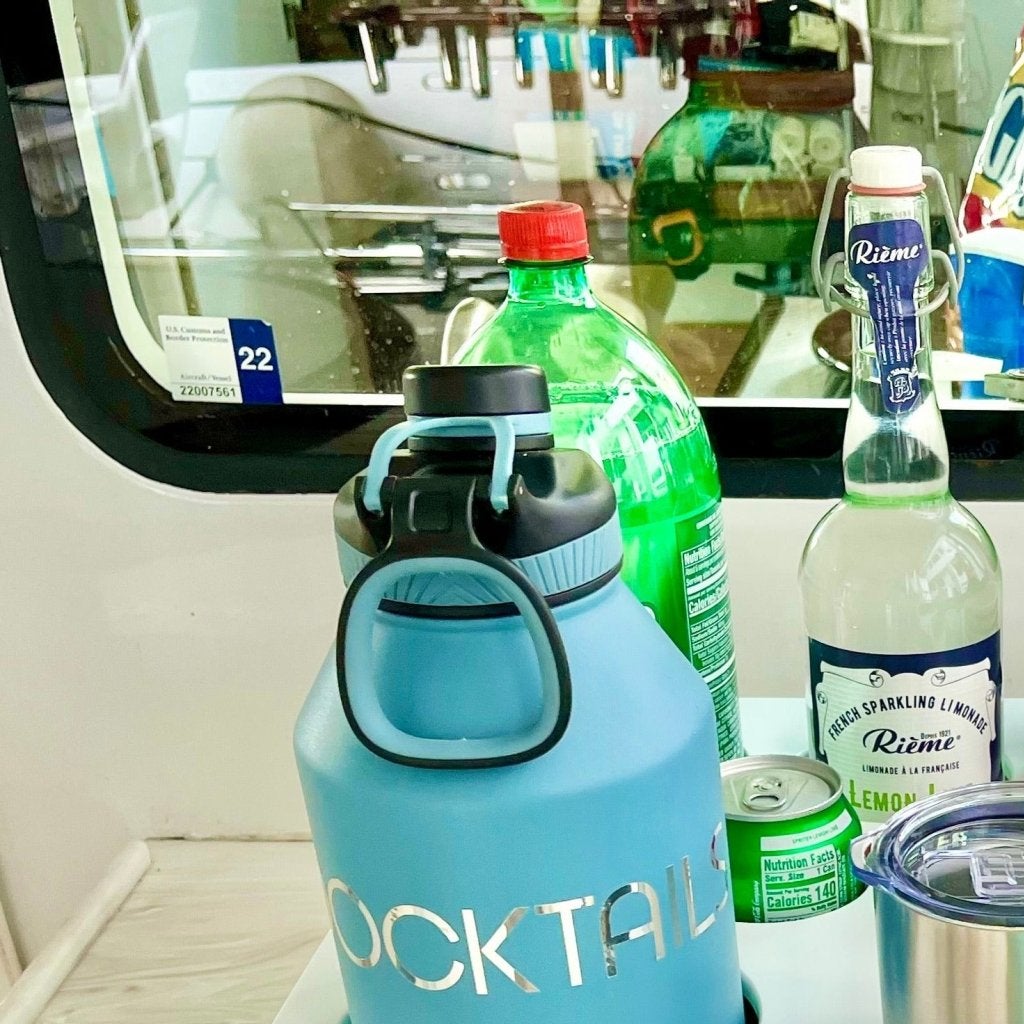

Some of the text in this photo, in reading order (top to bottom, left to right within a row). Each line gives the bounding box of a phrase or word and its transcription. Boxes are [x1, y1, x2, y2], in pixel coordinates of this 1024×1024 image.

[238, 346, 274, 371] 22
[180, 385, 236, 397] 22007561
[828, 696, 988, 742] FRENCH SPARKLING LIMONADE
[862, 761, 960, 775] LIMONADE À LA FRANÇAISE
[764, 850, 835, 872] Nutrition Facts
[788, 873, 804, 881] Size
[822, 863, 836, 873] Can
[767, 894, 813, 908] Calories
[815, 880, 836, 900] 140
